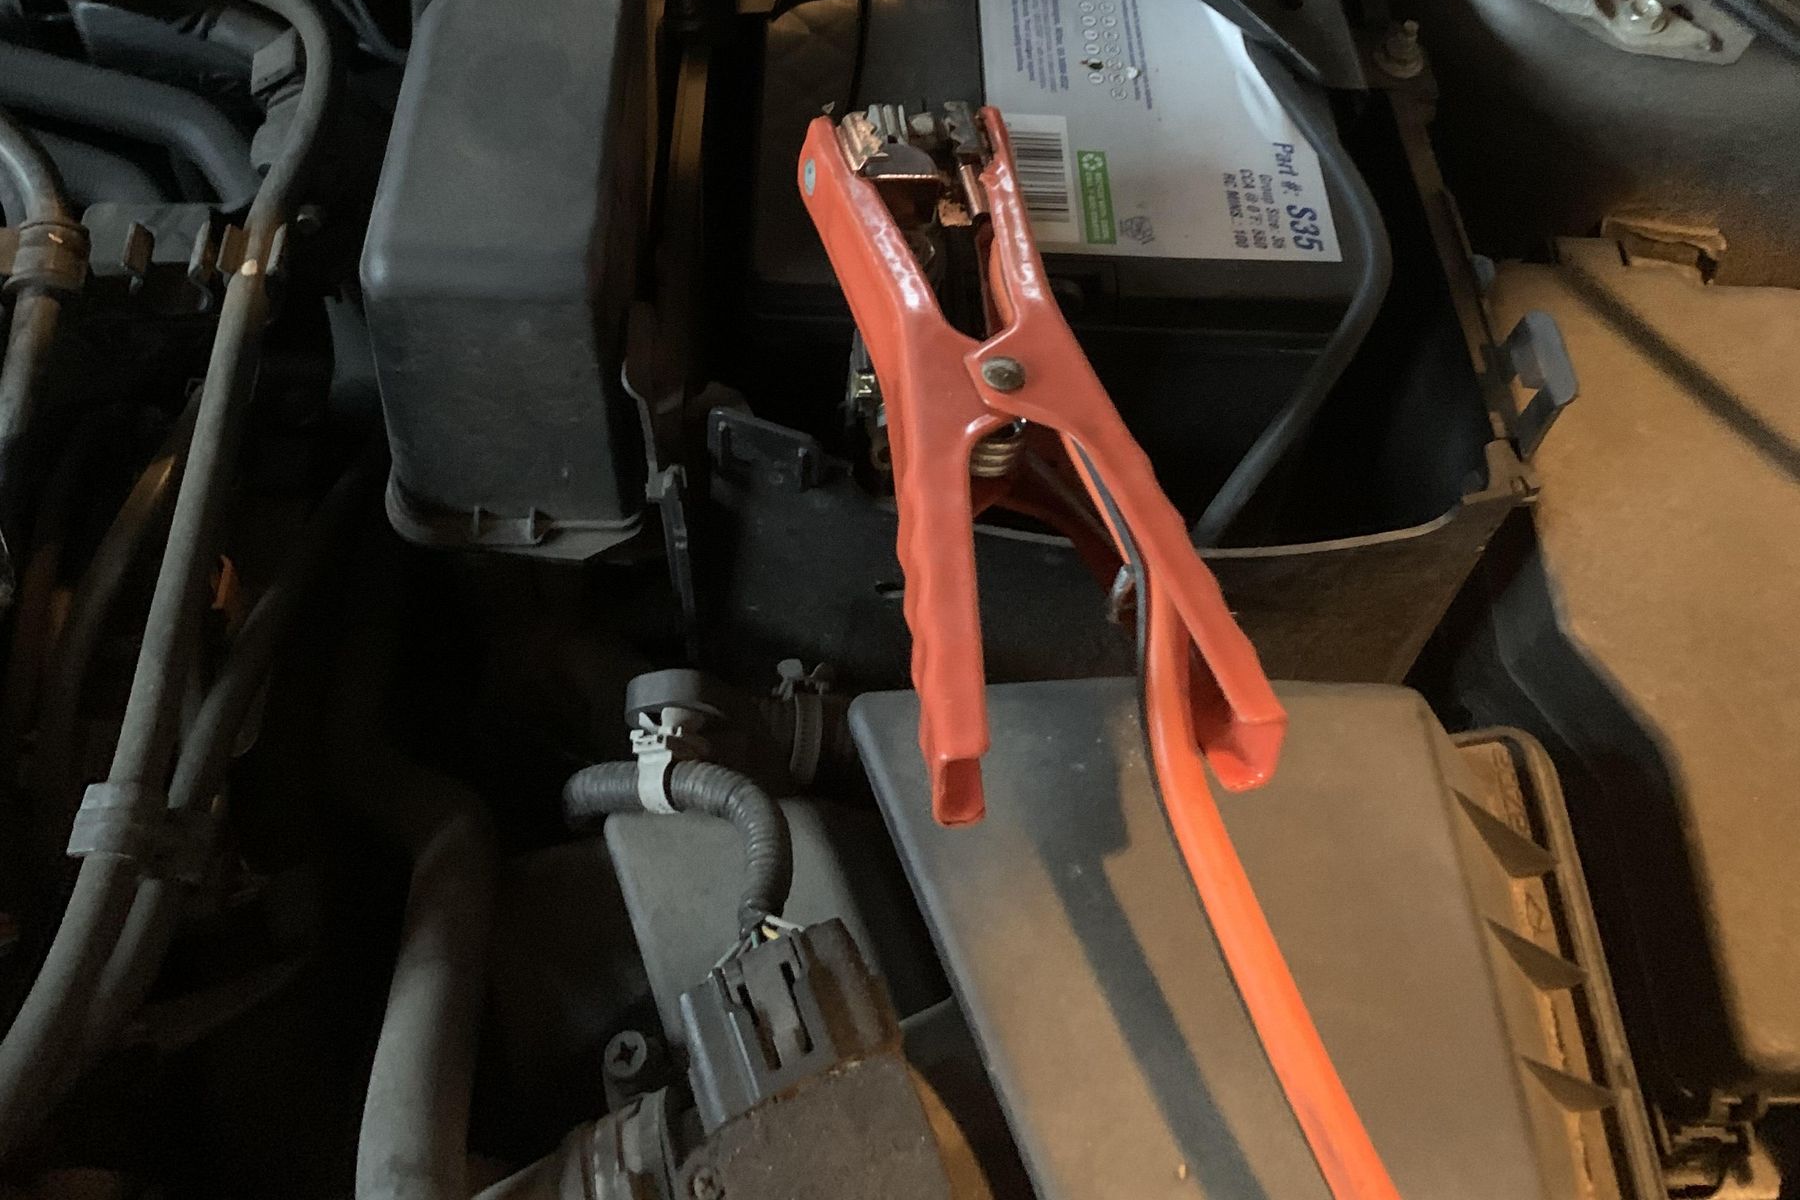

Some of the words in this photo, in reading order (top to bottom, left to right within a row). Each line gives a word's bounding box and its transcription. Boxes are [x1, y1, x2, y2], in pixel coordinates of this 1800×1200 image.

[1239, 168, 1256, 189] CCA
[1258, 173, 1275, 205] Group
[1272, 142, 1299, 176] Part
[1286, 204, 1325, 252] S35
